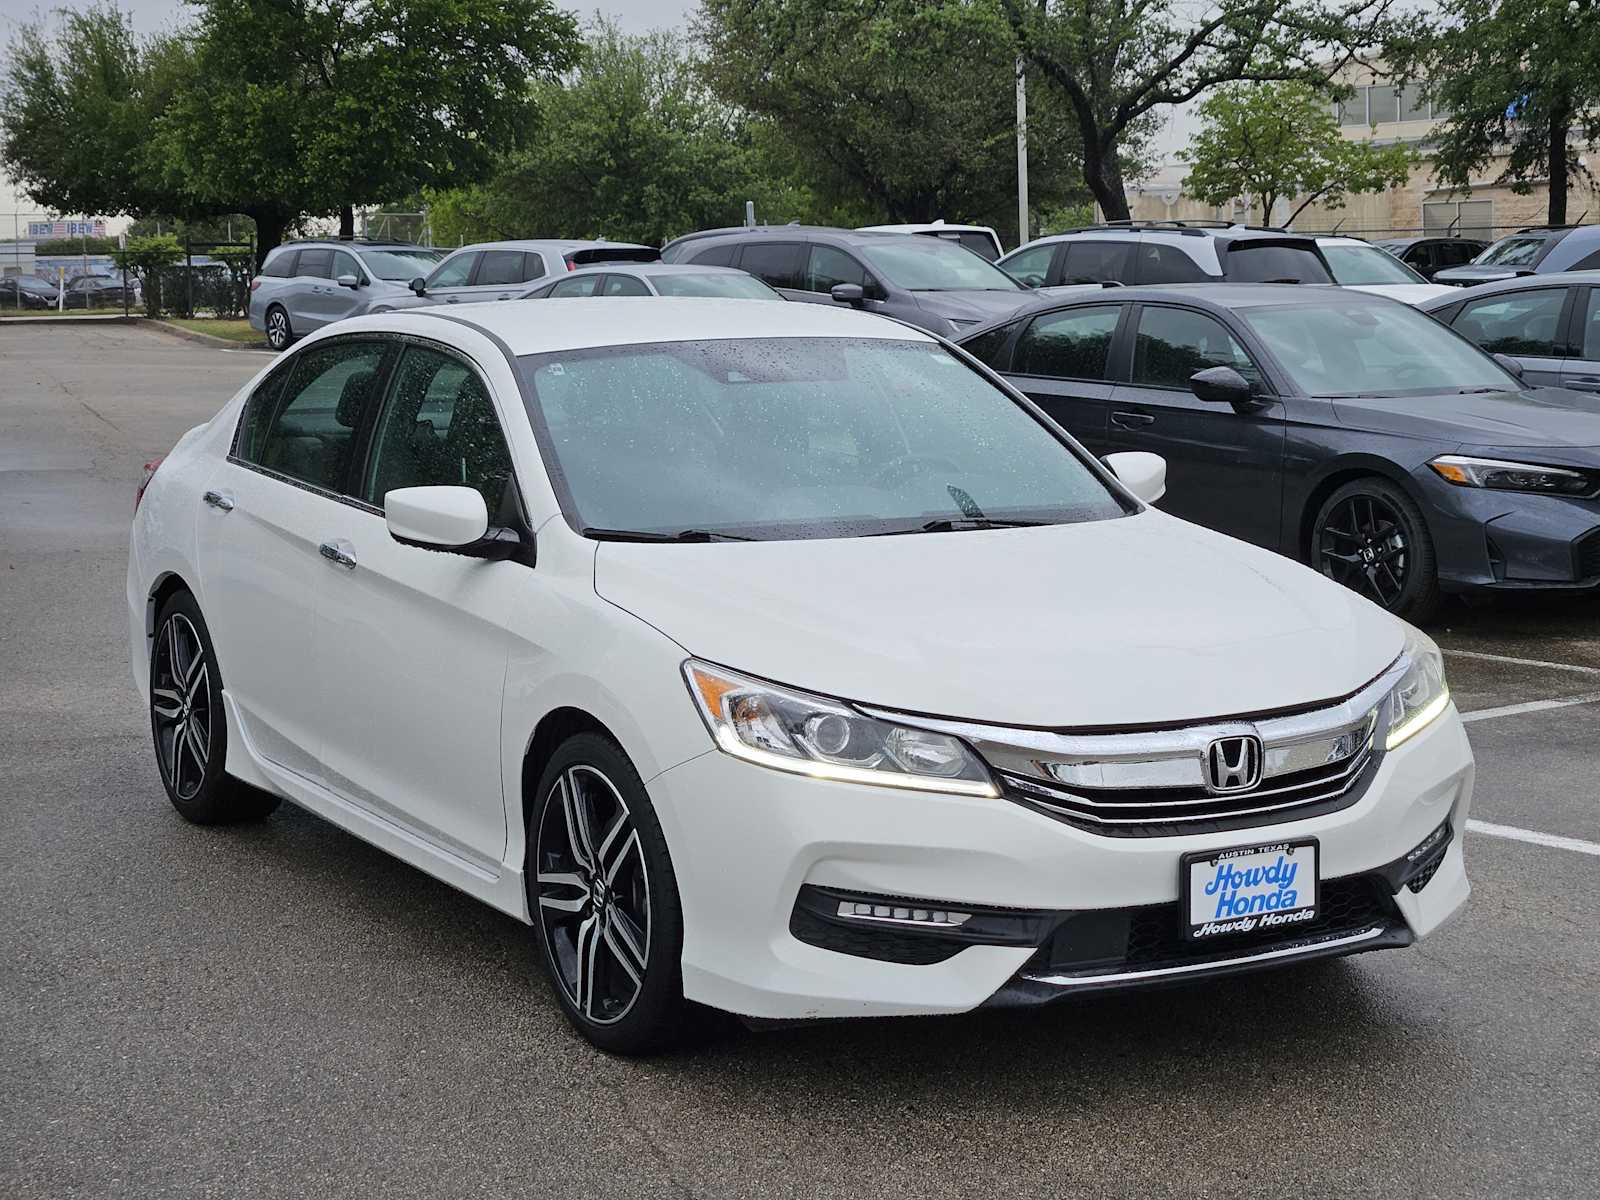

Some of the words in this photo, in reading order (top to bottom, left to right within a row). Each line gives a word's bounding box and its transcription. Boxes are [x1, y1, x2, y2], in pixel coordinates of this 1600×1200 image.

[1218, 849, 1254, 859] AUSTIN
[1258, 843, 1290, 853] TEXAS
[1205, 855, 1298, 895] Howdy
[1215, 889, 1298, 918] Honda
[1193, 917, 1255, 937] Howdy
[1258, 909, 1315, 927] Honda
